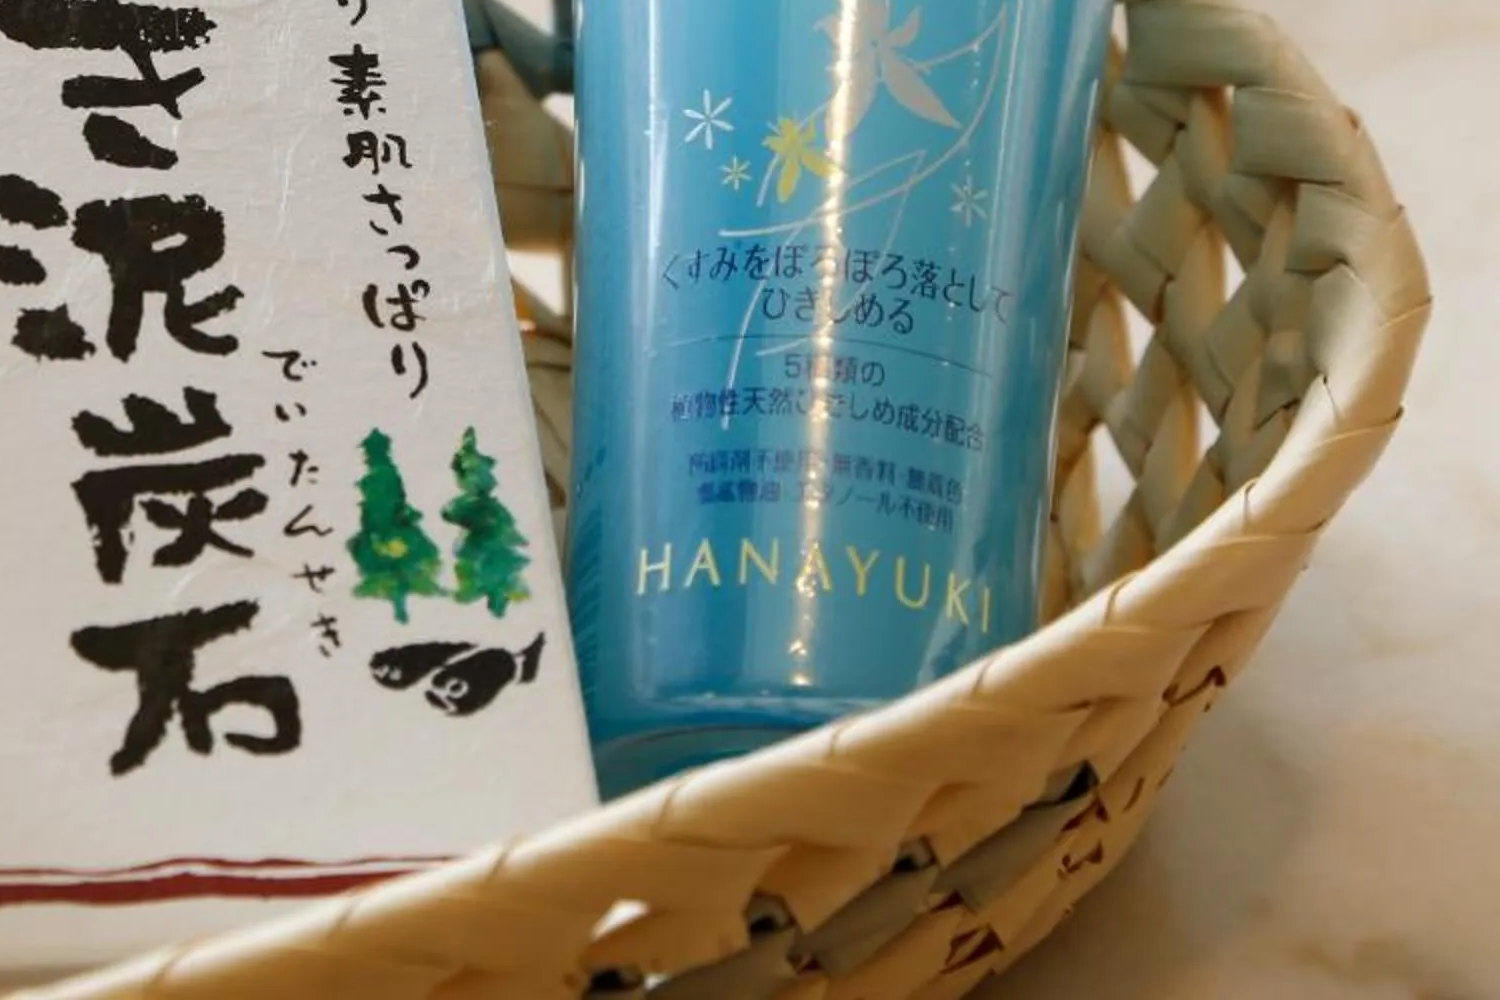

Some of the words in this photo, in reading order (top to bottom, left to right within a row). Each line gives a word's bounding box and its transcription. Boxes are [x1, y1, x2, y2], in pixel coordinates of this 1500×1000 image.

[261, 348, 342, 659] でいたんせき
[634, 536, 994, 635] HANAYUKI
